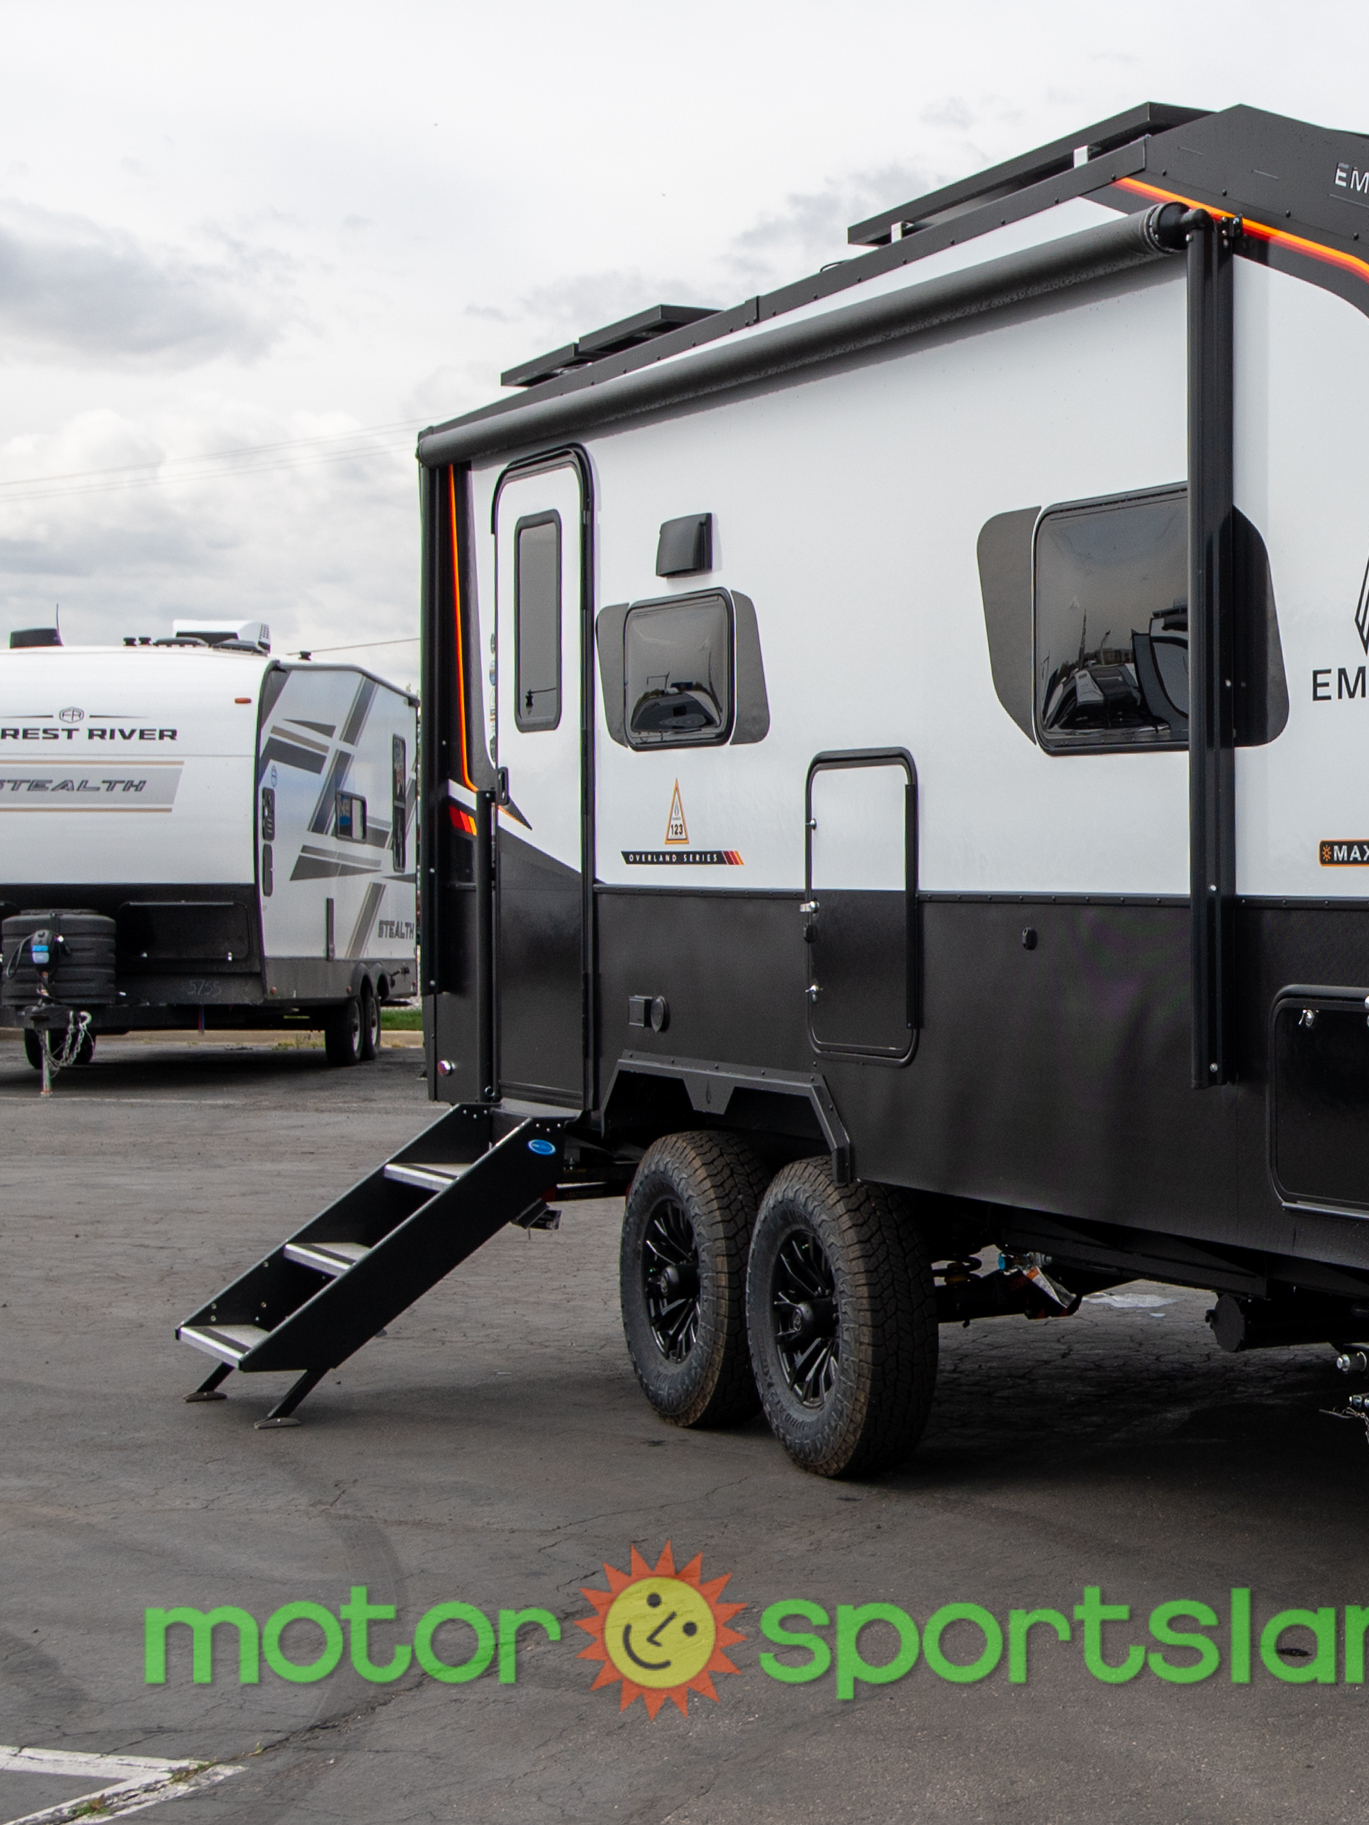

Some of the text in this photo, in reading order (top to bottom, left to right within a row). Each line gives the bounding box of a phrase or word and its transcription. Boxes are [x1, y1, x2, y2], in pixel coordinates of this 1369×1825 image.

[87, 728, 178, 741] RIVER
[0, 779, 147, 792] TEALTH
[671, 823, 684, 836] 123
[629, 853, 718, 863] OVERLAND SERIES
[378, 919, 414, 940] STEALTH
